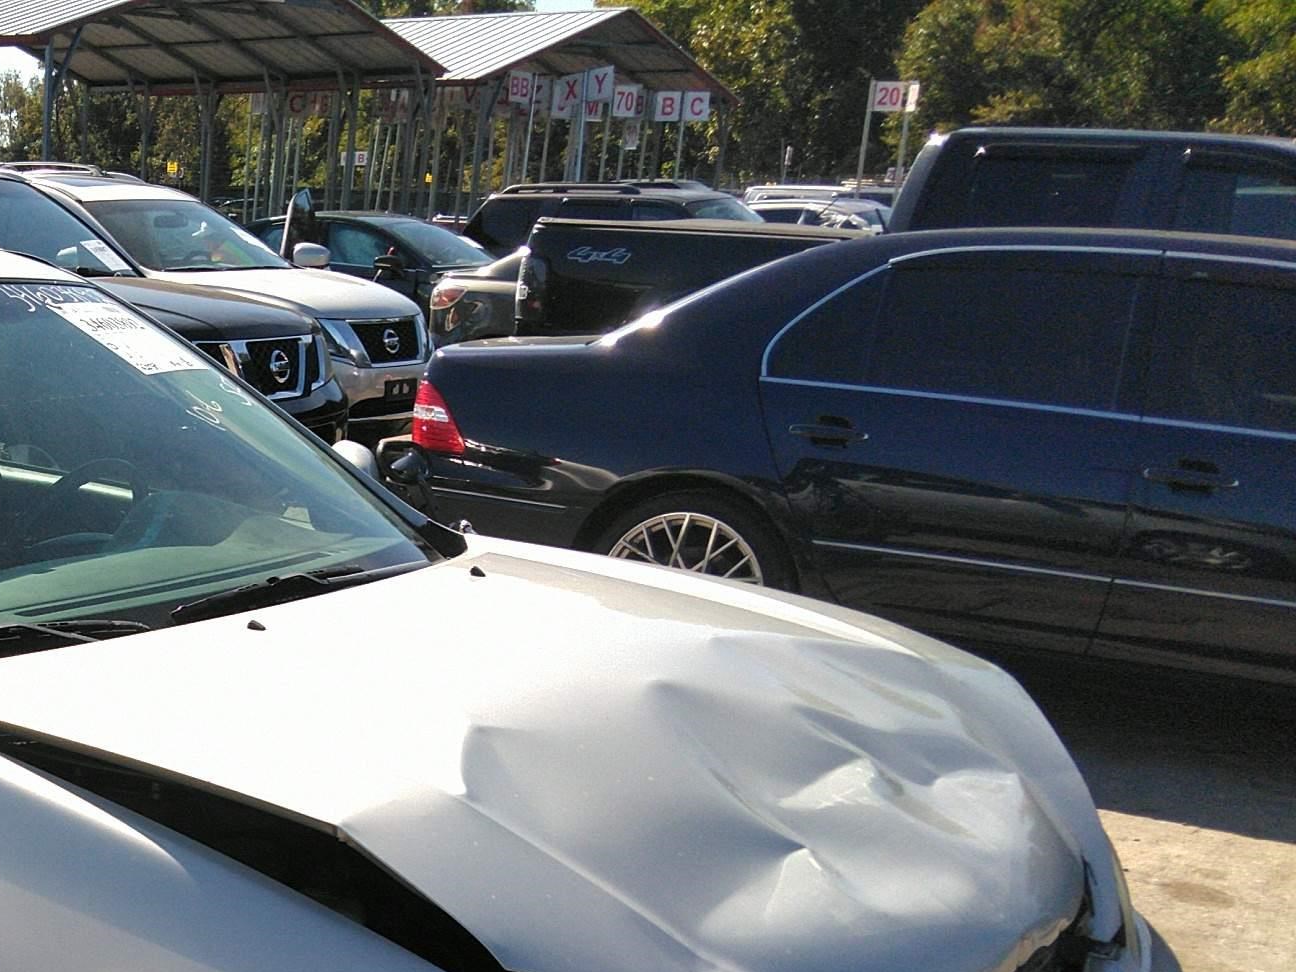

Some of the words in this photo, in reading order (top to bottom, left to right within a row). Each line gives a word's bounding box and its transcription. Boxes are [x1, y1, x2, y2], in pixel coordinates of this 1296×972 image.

[511, 77, 529, 97] BB
[566, 80, 577, 100] X
[594, 73, 608, 94] Y
[616, 91, 634, 112] 70
[877, 86, 901, 106] 20
[661, 97, 675, 117] B
[690, 97, 703, 117] C
